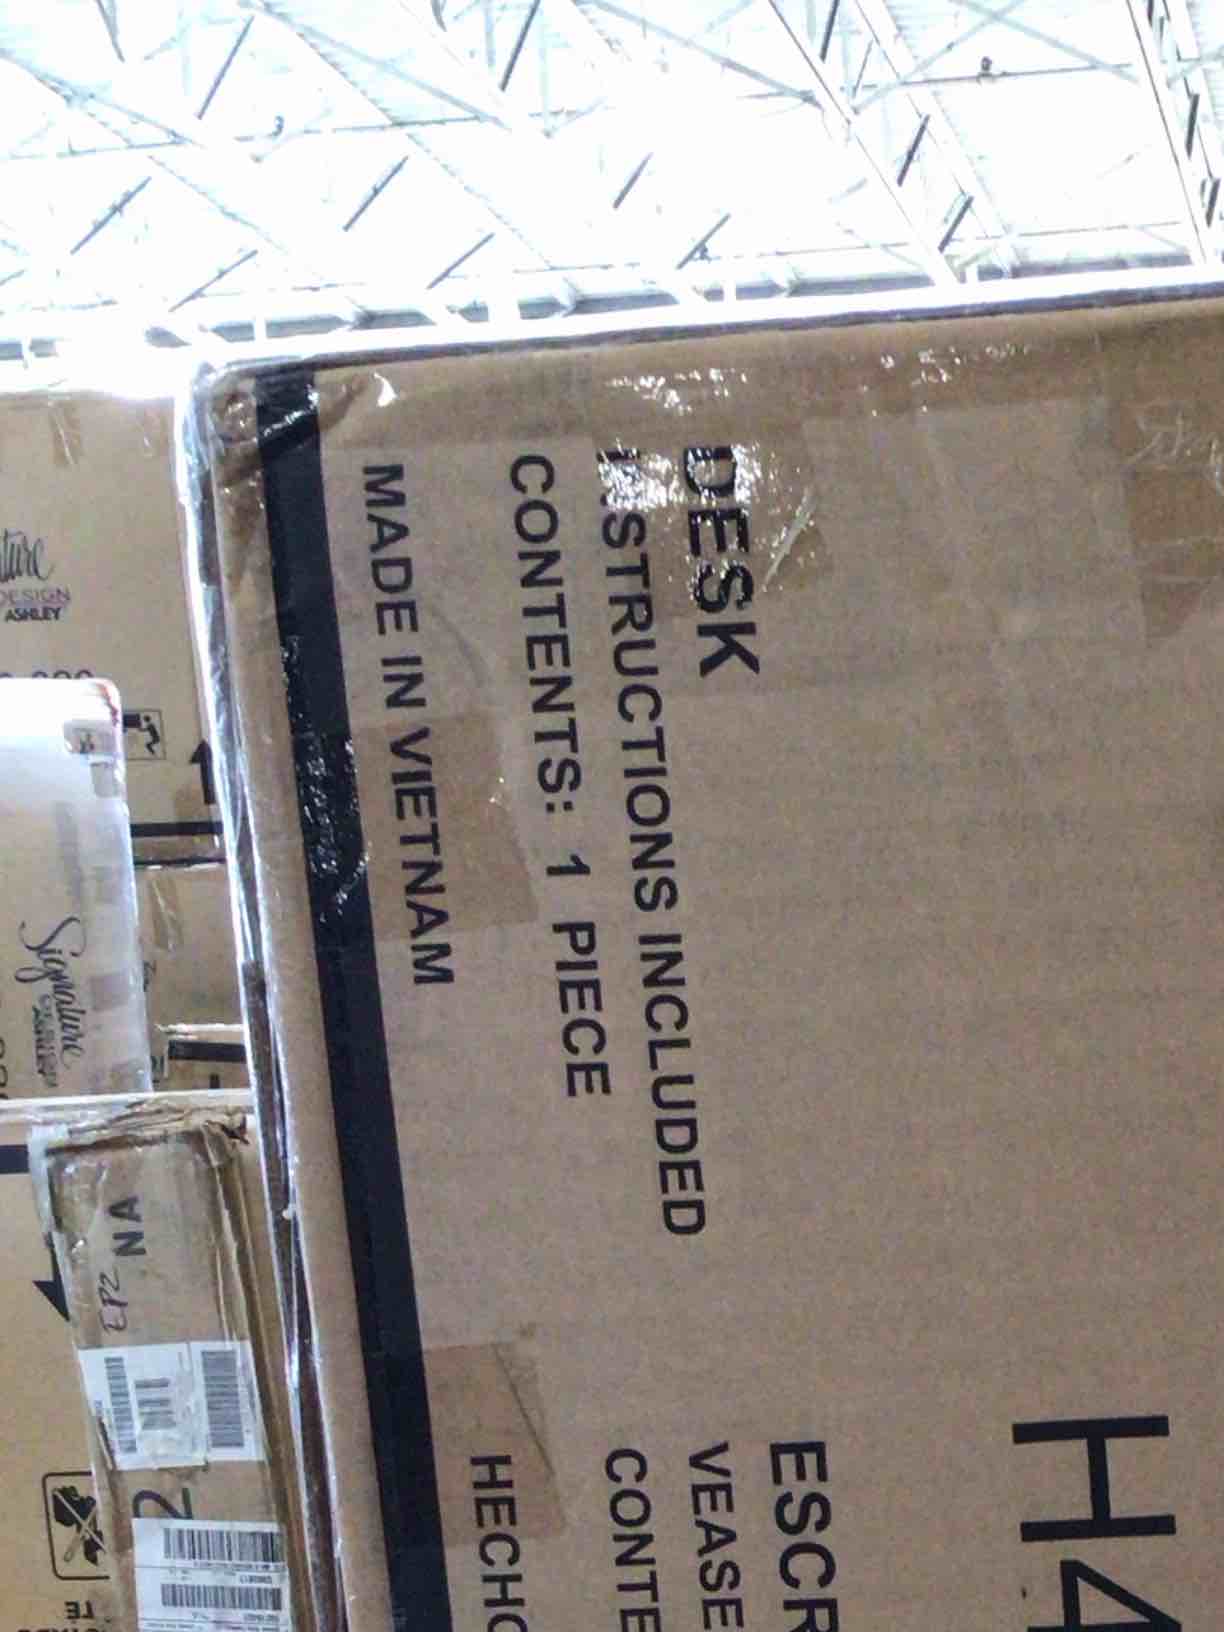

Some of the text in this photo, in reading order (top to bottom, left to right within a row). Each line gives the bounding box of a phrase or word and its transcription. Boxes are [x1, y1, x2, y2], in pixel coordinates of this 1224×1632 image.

[362, 464, 454, 986] MADE IN VIETNAM
[683, 441, 761, 679] DESK
[509, 454, 611, 1097] CONTENTS: 1 PIECE
[599, 441, 707, 1236] ISTRUCTIONS INCLUDED
[109, 1196, 147, 1257] NA
[687, 1442, 744, 1630] VEASE
